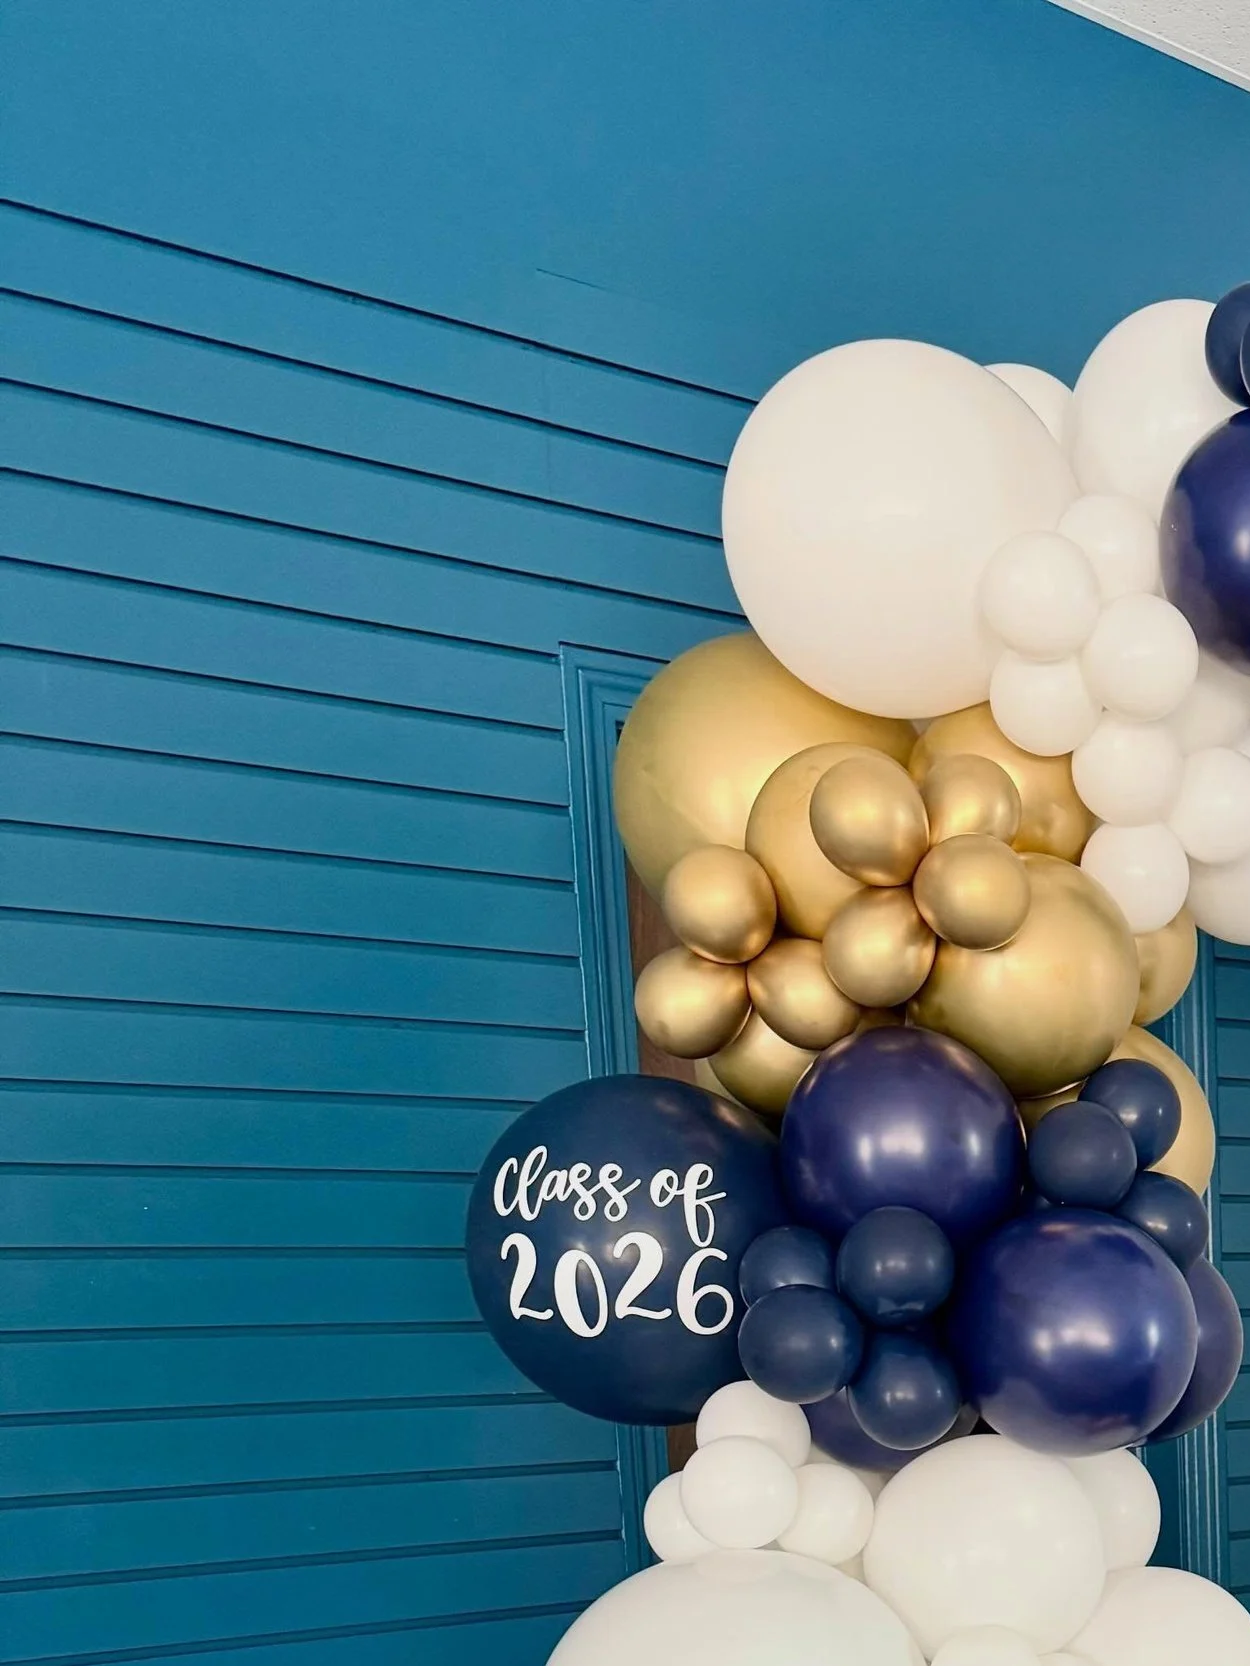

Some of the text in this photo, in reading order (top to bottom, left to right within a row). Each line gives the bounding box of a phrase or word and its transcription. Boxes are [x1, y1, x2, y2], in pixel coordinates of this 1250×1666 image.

[493, 1145, 727, 1248] Class of
[500, 1231, 734, 1338] 2026
